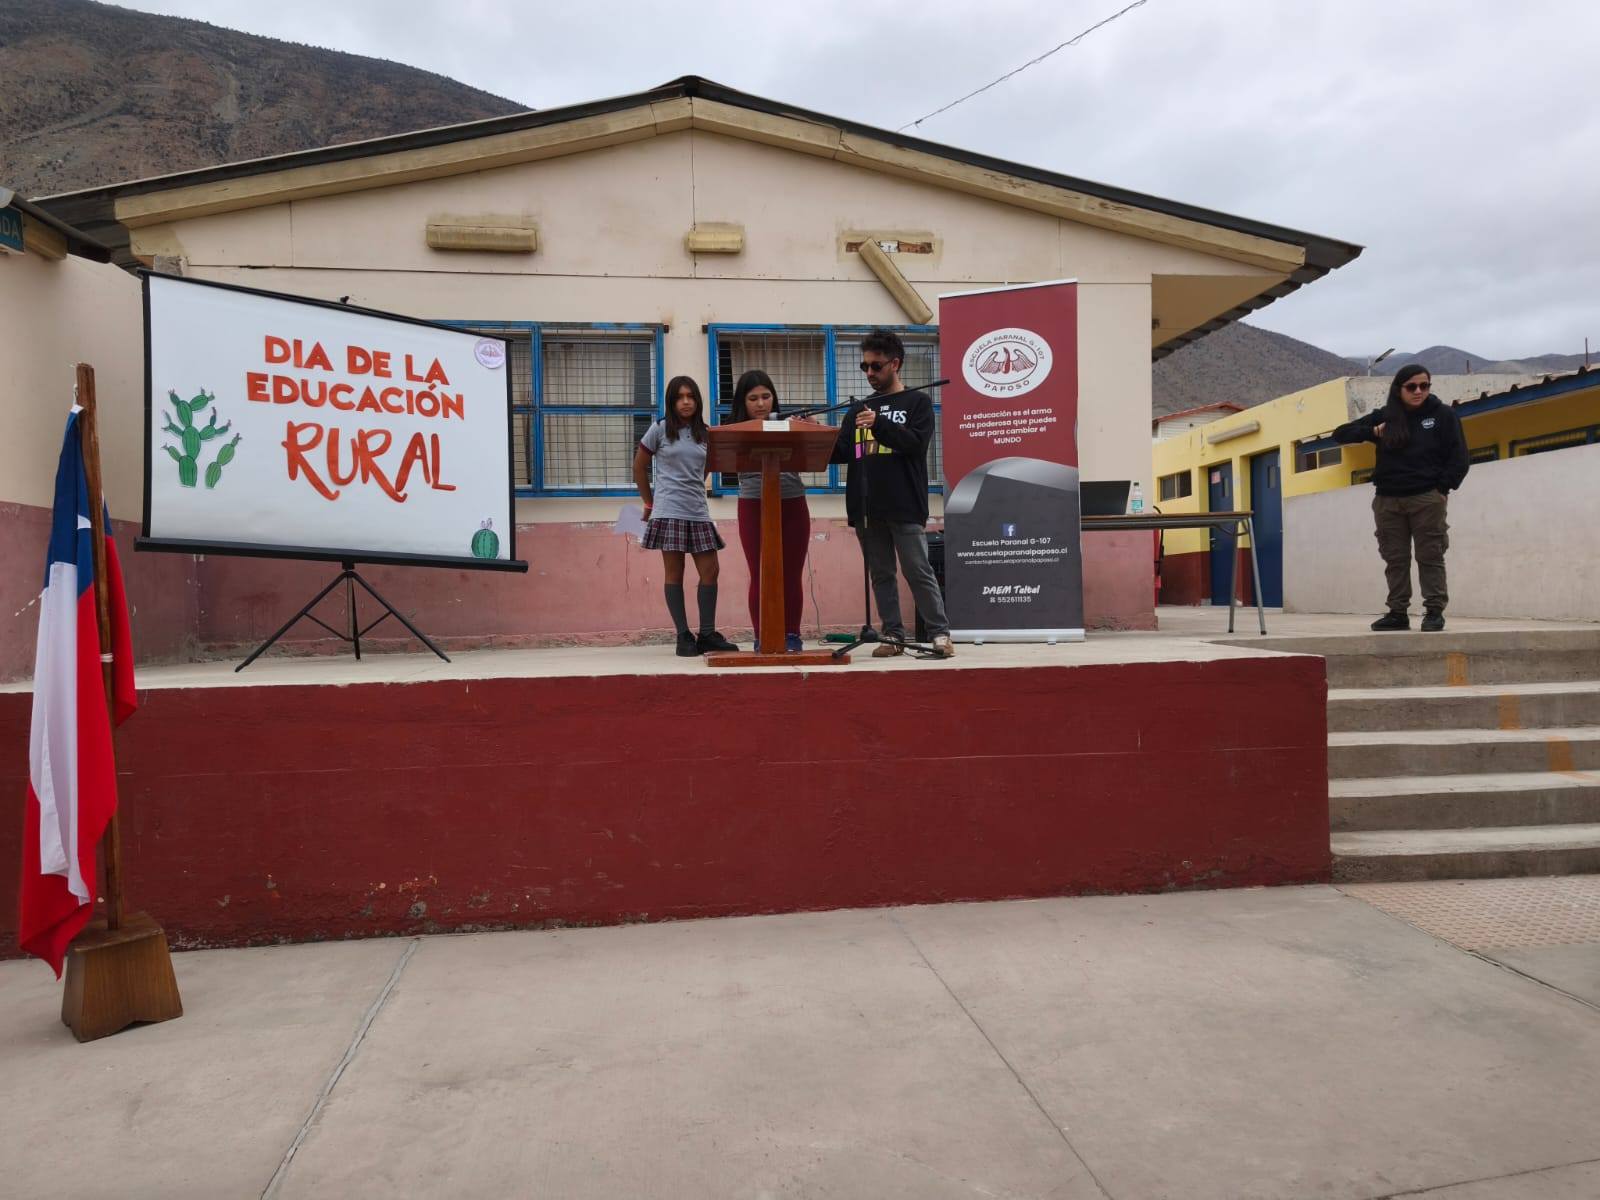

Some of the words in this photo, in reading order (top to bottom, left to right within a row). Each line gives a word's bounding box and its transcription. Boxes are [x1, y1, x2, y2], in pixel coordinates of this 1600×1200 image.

[969, 340, 992, 367] ESCUELA
[994, 334, 1027, 342] PARANAL
[264, 335, 334, 372] DIA
[347, 345, 392, 379] DE
[405, 354, 450, 386] LA
[984, 379, 1030, 392] PAPOSO
[246, 371, 464, 420] EDUCACIÓN
[973, 410, 1011, 419] educación
[959, 421, 975, 430] más
[976, 420, 1011, 430] poderosa
[1013, 419, 1028, 427] que
[1029, 416, 1057, 426] puedes
[987, 430, 1005, 438] para
[1006, 427, 1038, 436] cambiar
[1040, 425, 1047, 433] el
[281, 420, 457, 503] RURAL
[1030, 537, 1051, 545] G-107
[957, 548, 1068, 558] www.escuelaparanalpaposo.cl
[982, 586, 1012, 595] DAEM
[1013, 584, 1041, 594] Taltal
